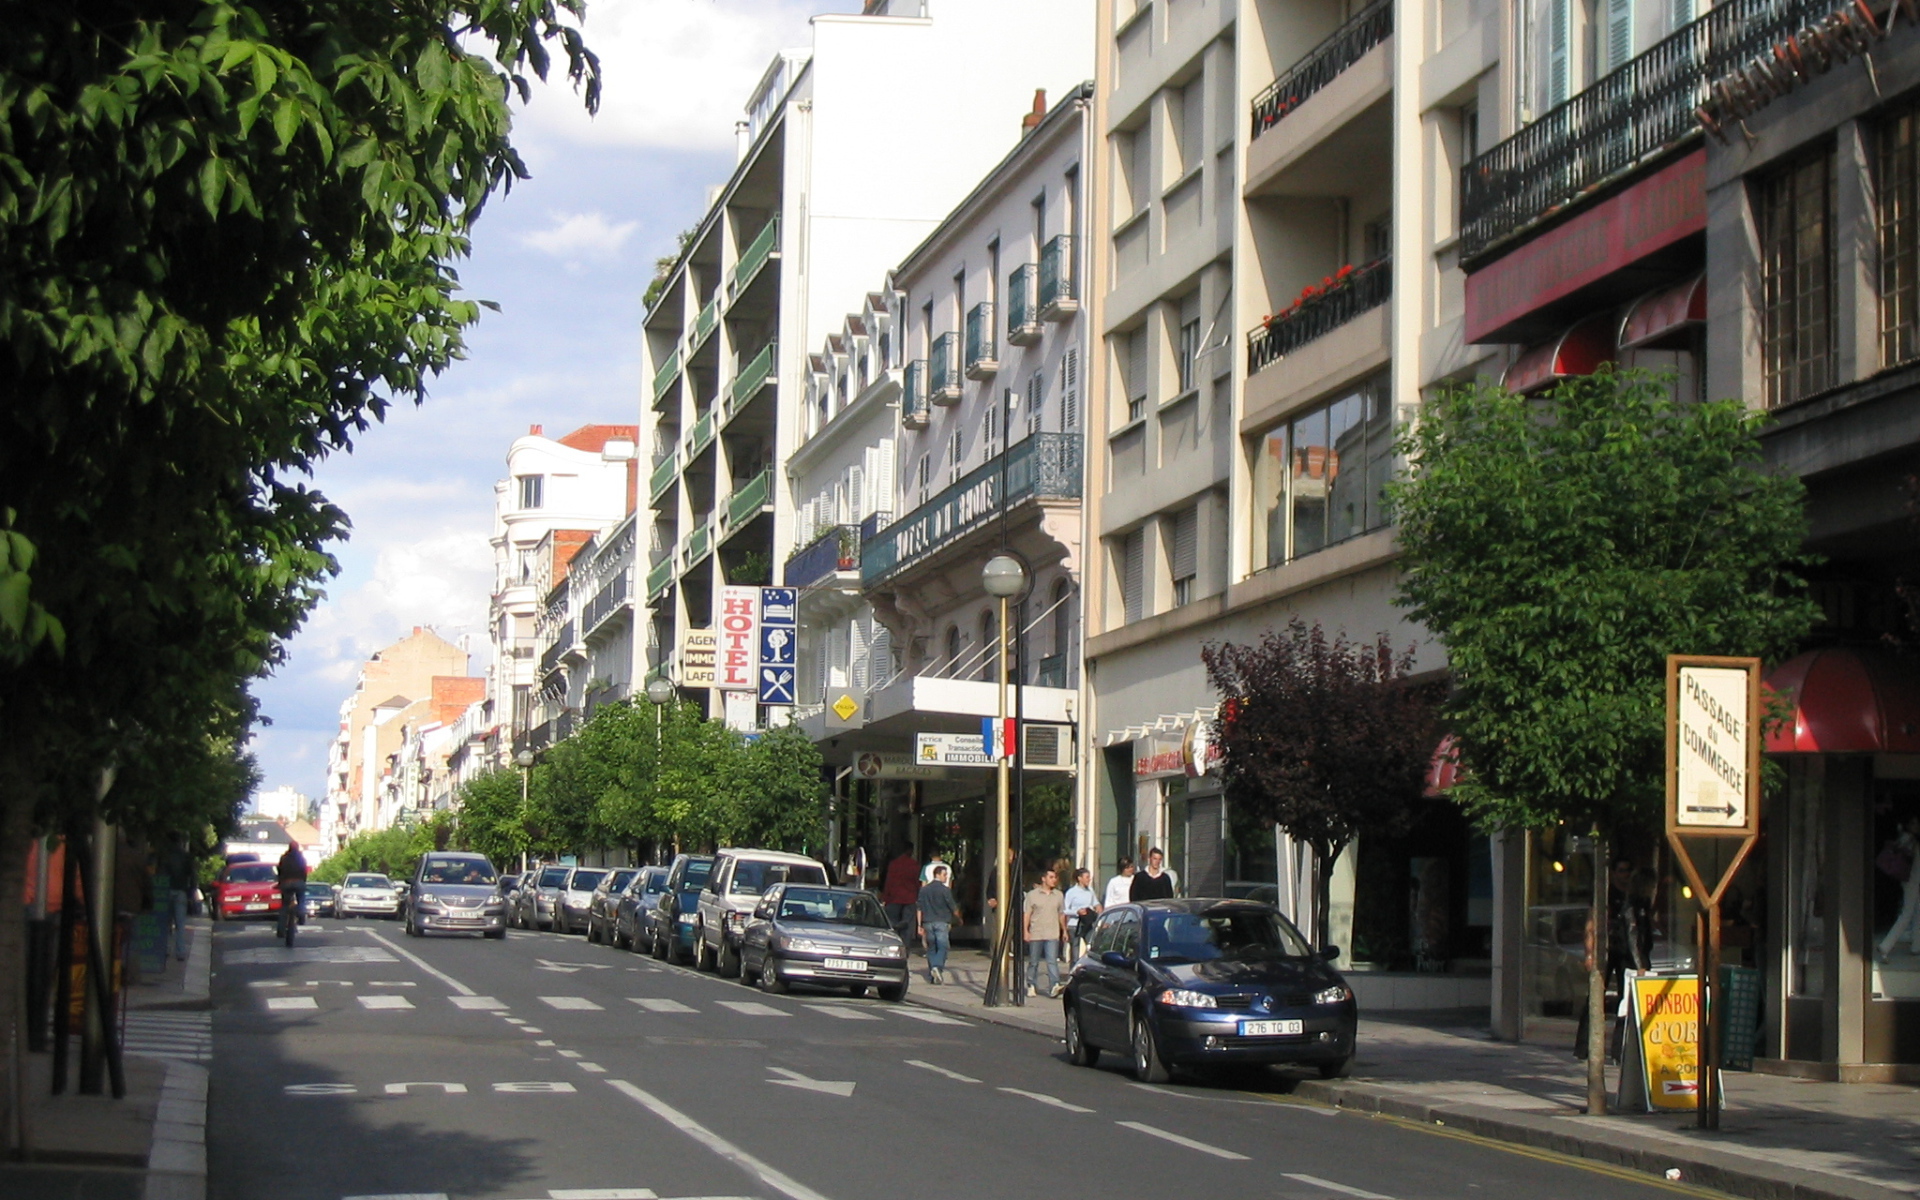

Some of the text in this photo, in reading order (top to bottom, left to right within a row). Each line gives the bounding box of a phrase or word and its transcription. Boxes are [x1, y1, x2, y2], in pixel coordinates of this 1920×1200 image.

[723, 598, 753, 684] HOTEL
[1686, 672, 1740, 743] PASSAGE
[1707, 723, 1719, 745] du
[1684, 722, 1743, 796] COMMERCE
[1248, 1022, 1267, 1034] 276
[1288, 1021, 1300, 1033] 03
[1660, 1064, 1670, 1075] A
